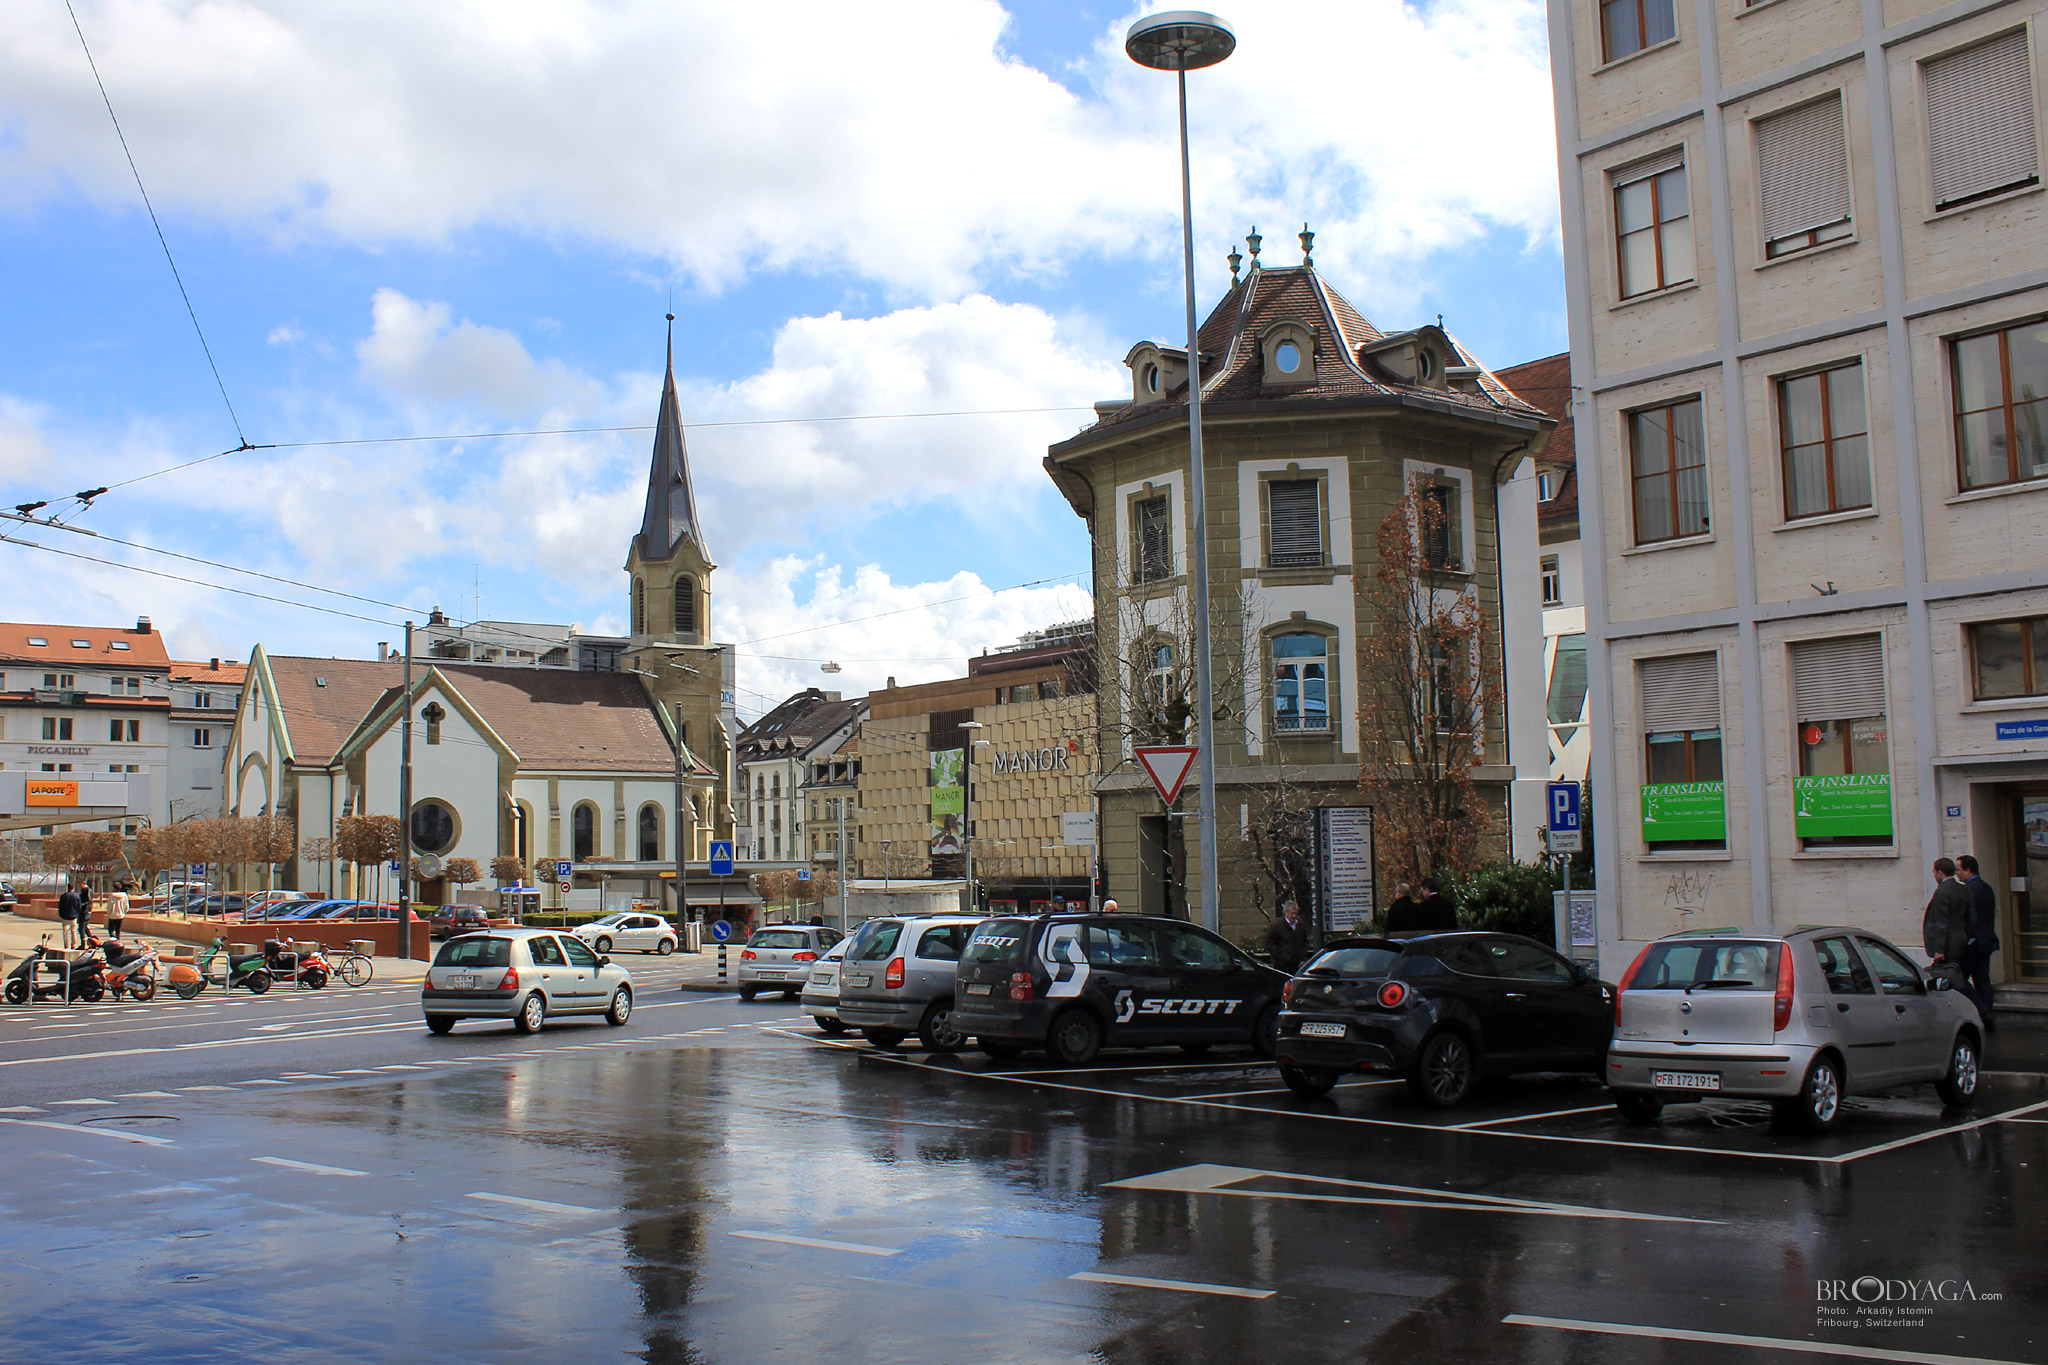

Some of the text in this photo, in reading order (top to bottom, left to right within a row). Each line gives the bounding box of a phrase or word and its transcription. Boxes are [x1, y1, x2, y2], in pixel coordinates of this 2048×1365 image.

[1999, 727, 2017, 735] Place
[27, 746, 92, 755] PICCADILLY
[993, 747, 1068, 775] MANOR
[1794, 774, 1890, 789] TRANSLINK
[41, 786, 65, 794] POSTE
[935, 790, 960, 801] MANOR
[1641, 782, 1724, 796] TRANSLINK
[1554, 790, 1569, 824] P
[1948, 807, 1959, 815] 15
[560, 864, 567, 874] P
[1323, 855, 1329, 870] DE
[1324, 877, 1330, 892] LA
[973, 935, 1020, 947] SCOTT
[1137, 998, 1243, 1014] SCOTT
